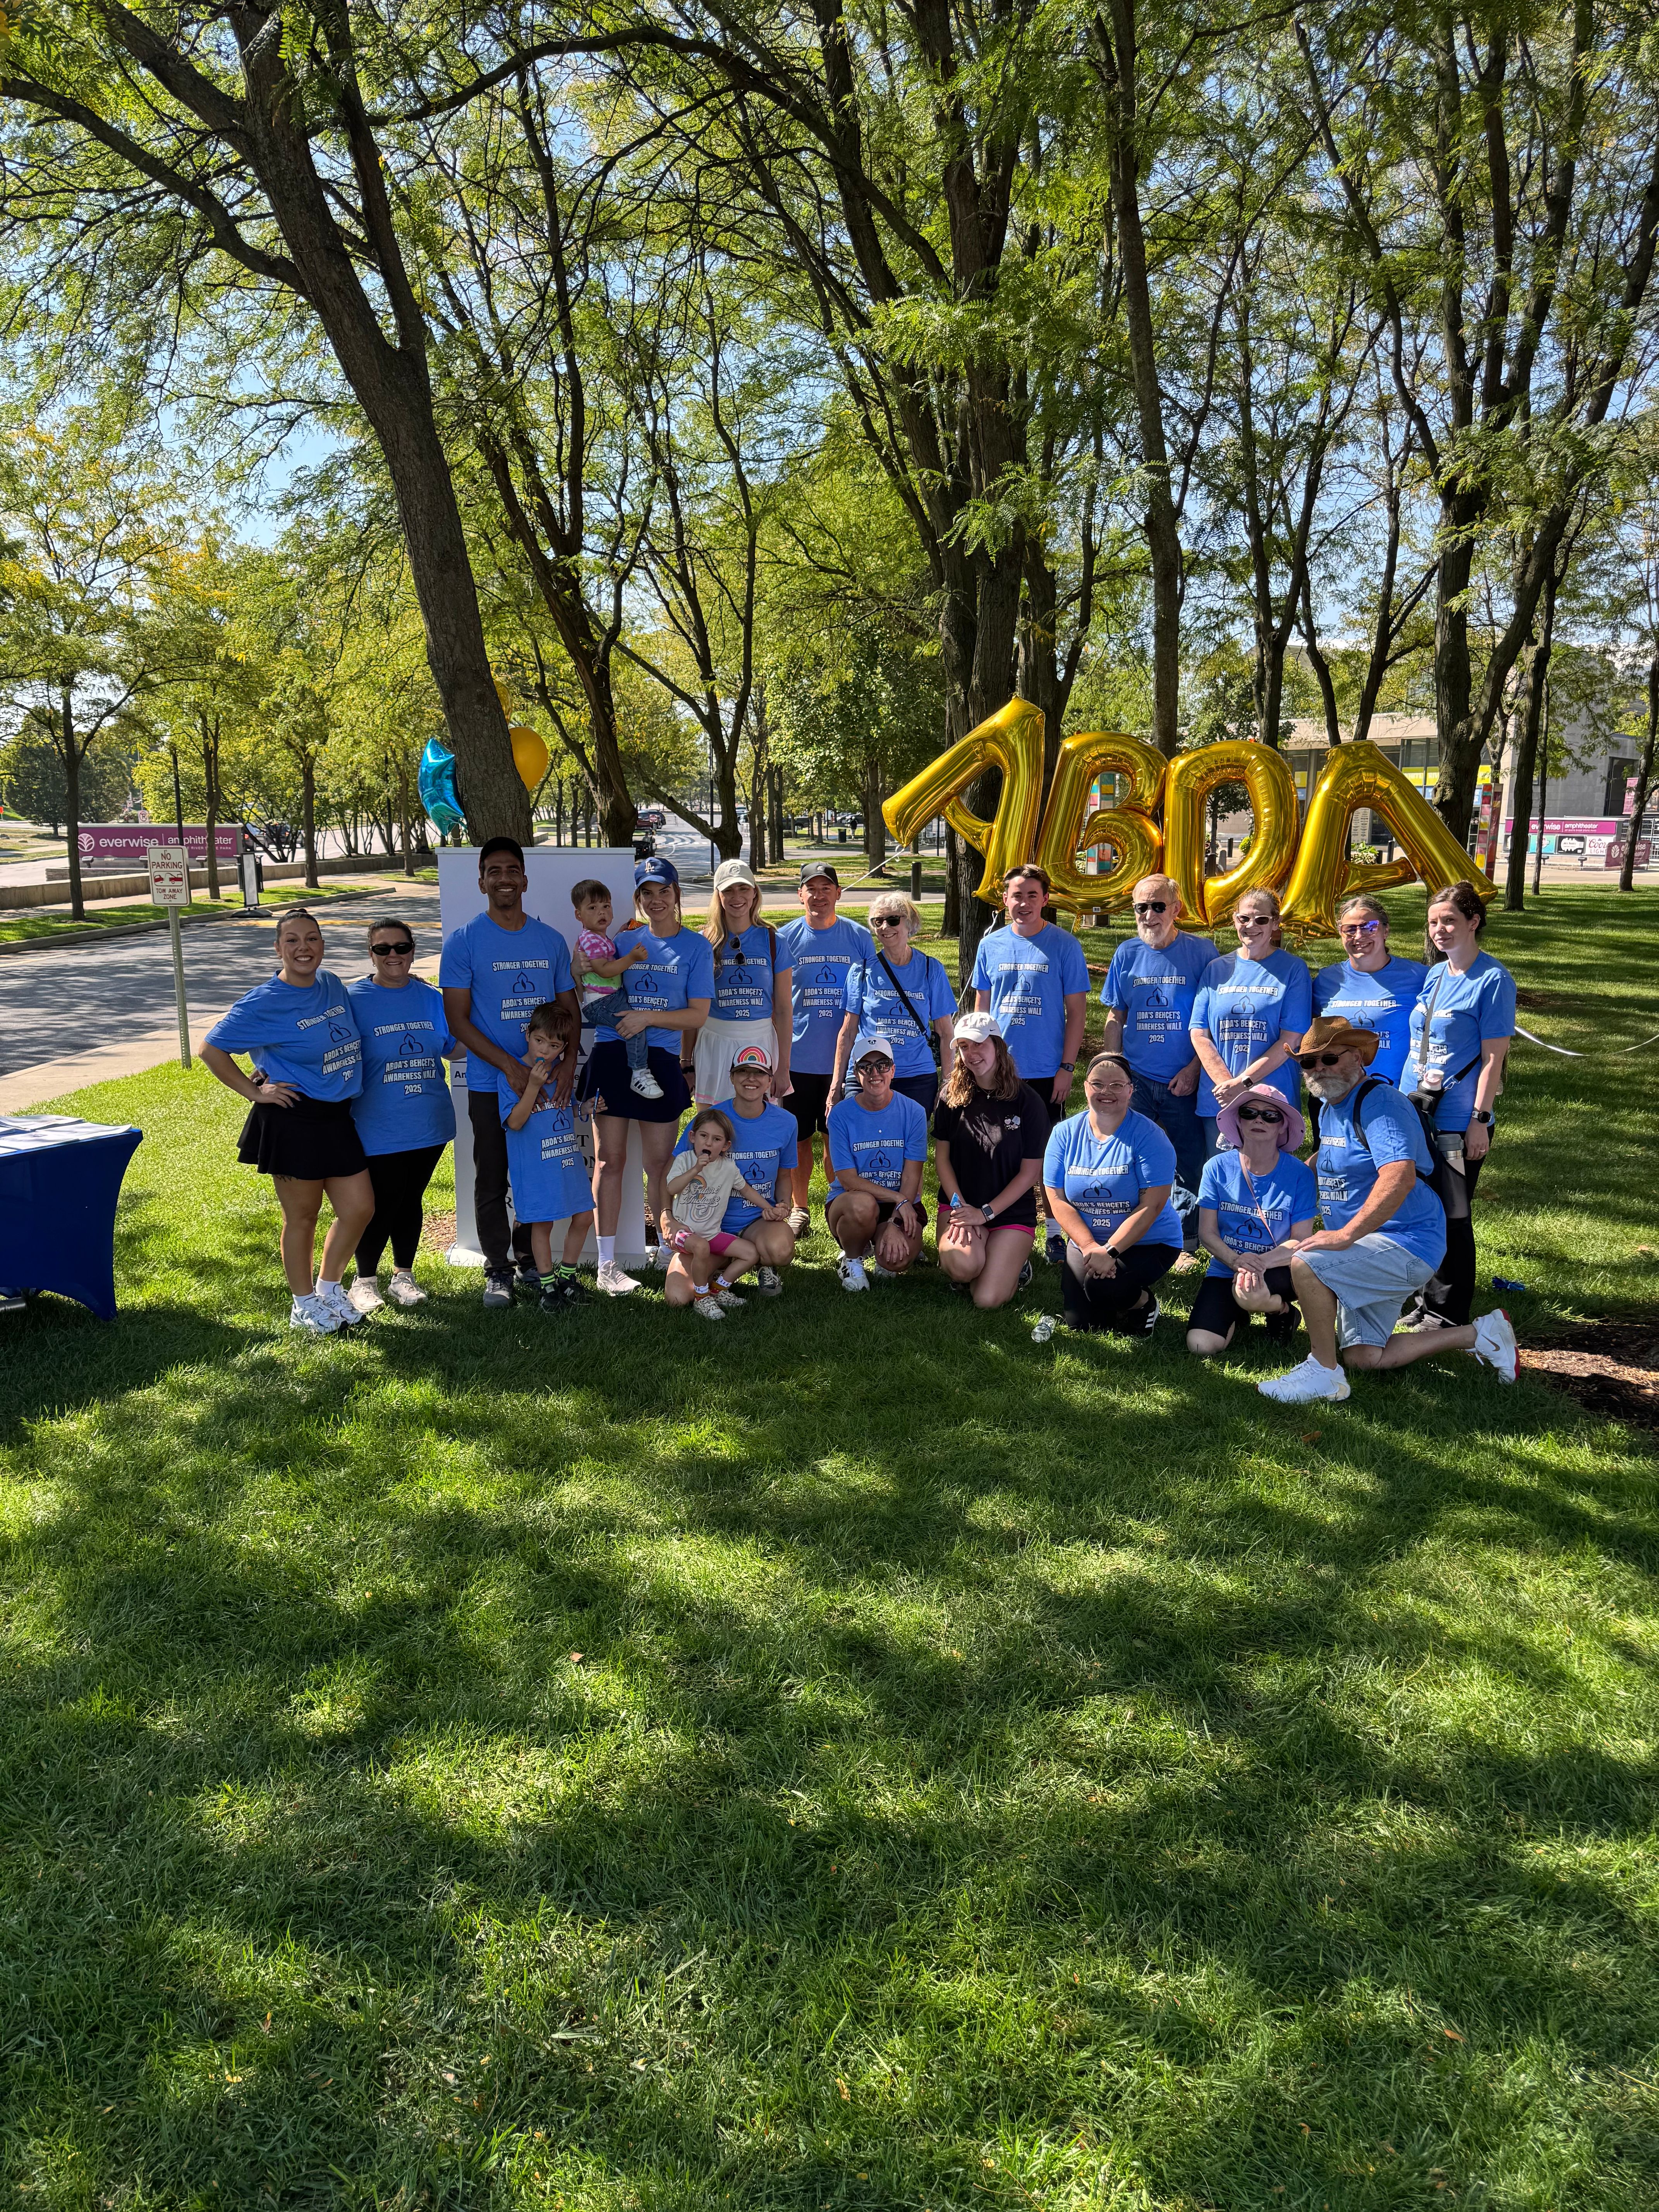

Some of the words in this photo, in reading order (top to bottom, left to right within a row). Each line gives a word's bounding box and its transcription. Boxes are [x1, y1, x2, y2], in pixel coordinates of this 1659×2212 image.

[100, 836, 159, 847] everwise
[168, 836, 233, 846] amphithater
[1589, 838, 1607, 848] Coor
[747, 958, 767, 966] GETHER
[799, 956, 825, 965] STRONGER
[826, 956, 850, 964] TOGETHER
[492, 961, 520, 972] STRONGER
[521, 960, 549, 969] TOGETHER
[651, 964, 678, 975] TOGETHER
[998, 963, 1023, 972] STRONGER
[1024, 963, 1049, 974] TOGETHER
[1133, 976, 1158, 988] STRONGER
[1158, 976, 1186, 985] TOGETHER
[718, 988, 737, 998] ABDA'S
[738, 988, 763, 997] BEHÇET'S
[804, 988, 823, 997] ABDA'S
[823, 988, 843, 997] BEHÇET
[903, 990, 925, 1000] OGETHER
[502, 998, 522, 1010] ABDA'S
[643, 996, 668, 1007] BEHÇET'S
[750, 998, 763, 1006] WALK
[803, 999, 833, 1007] AWARENESS
[735, 1009, 750, 1018] 2025
[818, 1010, 833, 1018] 2025
[1028, 1007, 1042, 1016] WALK
[1137, 1011, 1154, 1021] ABDA'S
[1155, 1011, 1180, 1021] BEHÇET'S
[296, 1015, 327, 1030] STRONGER
[1011, 1017, 1025, 1026] 2025
[1136, 1022, 1165, 1031] AWARENESS
[1166, 1021, 1182, 1030] WALK
[374, 1023, 406, 1037] STRONGER
[406, 1020, 435, 1030] TOGETHER
[876, 1027, 906, 1035] AWARENESS
[890, 1037, 905, 1046] 2025
[1149, 1034, 1165, 1044] 2025
[1252, 1032, 1267, 1042] WALK
[1378, 1040, 1391, 1049] ALK
[324, 1046, 343, 1064] ABDA'S
[322, 1055, 356, 1075] AWARENESS
[385, 1060, 408, 1073] ABDA'S
[409, 1058, 435, 1069] BEHÇET'S
[383, 1072, 422, 1084] AWARENESS
[422, 1069, 436, 1079] WALK
[404, 1084, 422, 1095] 2025
[541, 1135, 562, 1149] ABDA'S
[853, 1140, 880, 1152] STRONGER
[541, 1146, 572, 1161] AWARENESS
[562, 1157, 574, 1170] 2025
[878, 1170, 902, 1179] BEHÇET'S
[1068, 1165, 1097, 1176] STRONGER
[1098, 1164, 1129, 1176] TOGETHER
[1331, 1190, 1348, 1202] WALK
[1096, 1200, 1130, 1209] BEHÇET'S
[1220, 1201, 1252, 1215] STRONGER
[1092, 1218, 1111, 1228] 2025
[1223, 1235, 1243, 1248] ABDA'S
